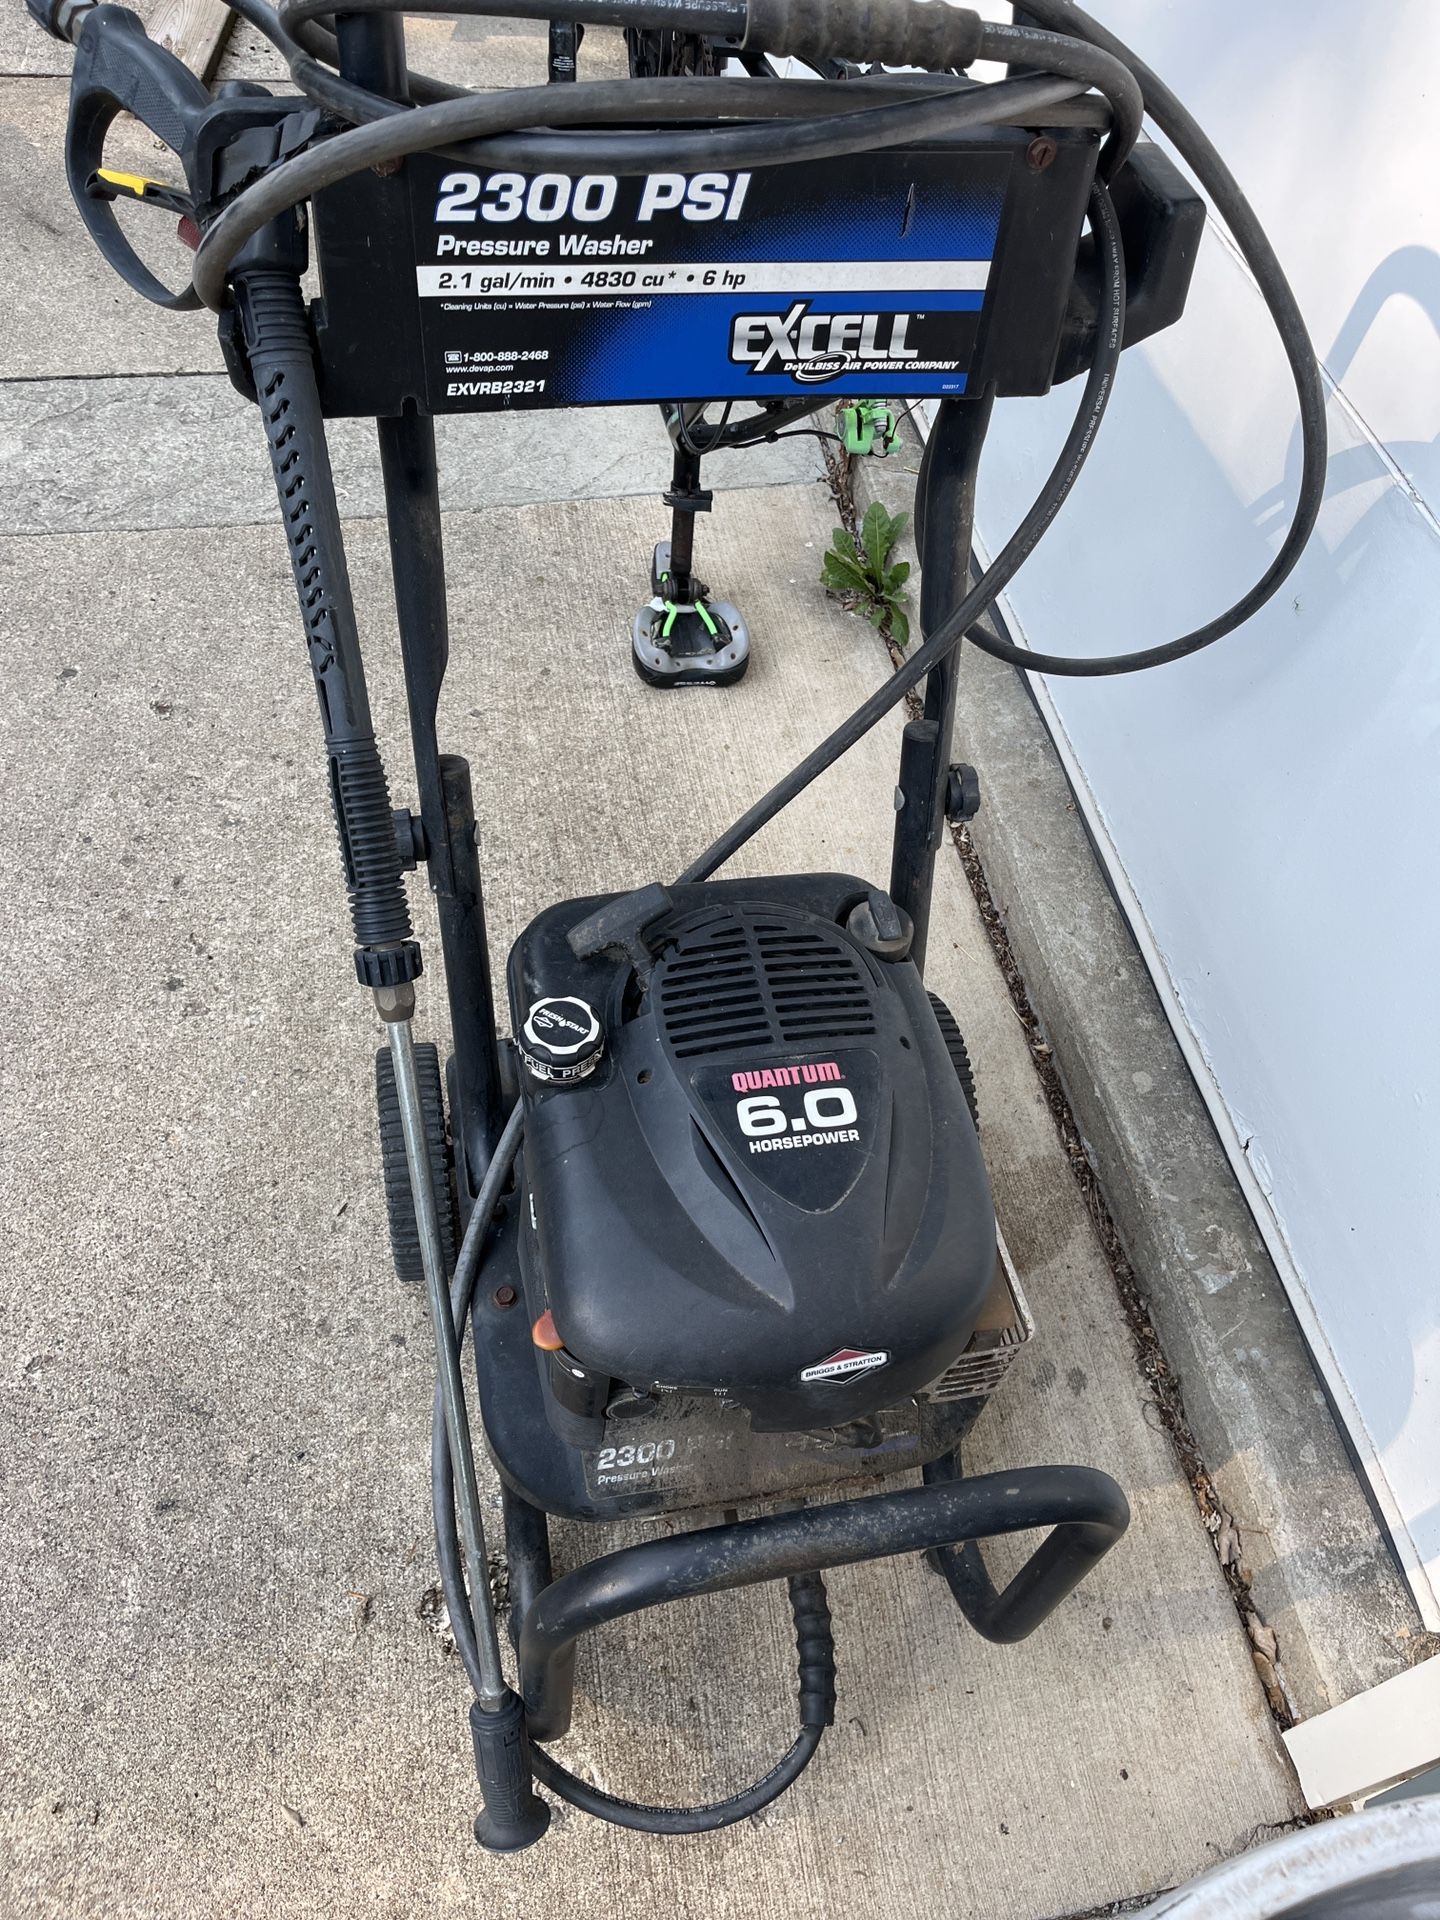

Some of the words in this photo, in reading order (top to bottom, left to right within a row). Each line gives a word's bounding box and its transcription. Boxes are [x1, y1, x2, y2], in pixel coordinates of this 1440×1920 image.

[435, 173, 618, 222] 2300
[637, 173, 752, 221] PSI
[436, 235, 550, 256] Pressure
[559, 234, 653, 255] Washer
[438, 272, 472, 289] 2.1
[480, 271, 555, 293] gal/min
[580, 271, 636, 287] 4830
[702, 270, 715, 286] 6
[721, 270, 746, 289] hp
[493, 302, 507, 311] (cu)
[538, 301, 570, 309] Pressure
[631, 301, 652, 309] (gpm)
[732, 304, 918, 371] EXCELL
[463, 351, 549, 362] 1-800-888-2468
[841, 361, 861, 369] AIR
[863, 361, 903, 370] POWER
[905, 361, 958, 370] COMPANY
[446, 364, 513, 373] www.devap.com
[447, 380, 545, 396] EXVRB2321
[565, 1020, 590, 1035] START
[524, 1055, 554, 1079] FUEL
[731, 1062, 842, 1093] QUANTUM
[736, 1087, 858, 1137] 6.0
[749, 1129, 860, 1154] HORSEPOWER
[805, 1366, 835, 1378] BRIGGS
[843, 1355, 882, 1369] STRATTON
[597, 1439, 675, 1470] 2300
[597, 1470, 649, 1485] Pressure
